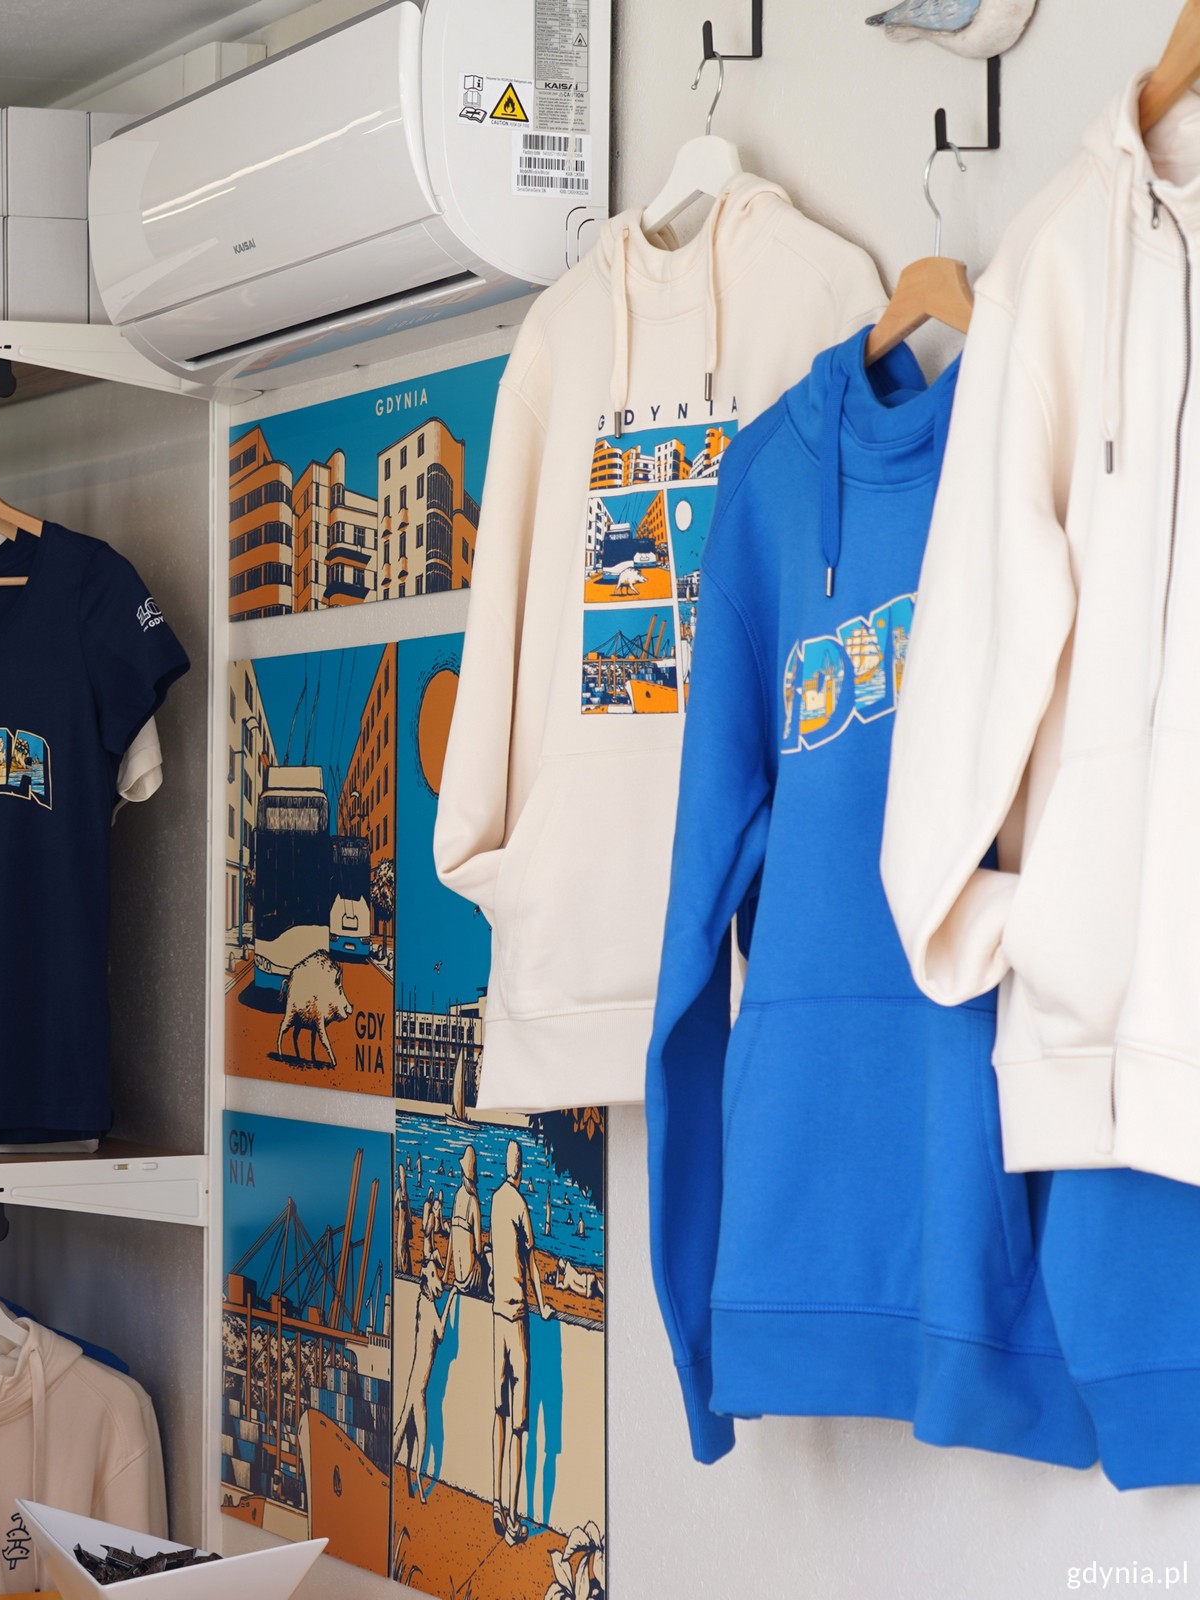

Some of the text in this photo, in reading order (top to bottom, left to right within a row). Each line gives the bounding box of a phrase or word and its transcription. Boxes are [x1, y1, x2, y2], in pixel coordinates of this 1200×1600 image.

[233, 238, 256, 254] KAISAI
[375, 388, 429, 416] GDYNIA
[598, 396, 738, 431] GDYNIA
[355, 1011, 385, 1041] GDY
[355, 1044, 385, 1075] NIA
[229, 1129, 255, 1157] GDY
[229, 1159, 256, 1187] NIA
